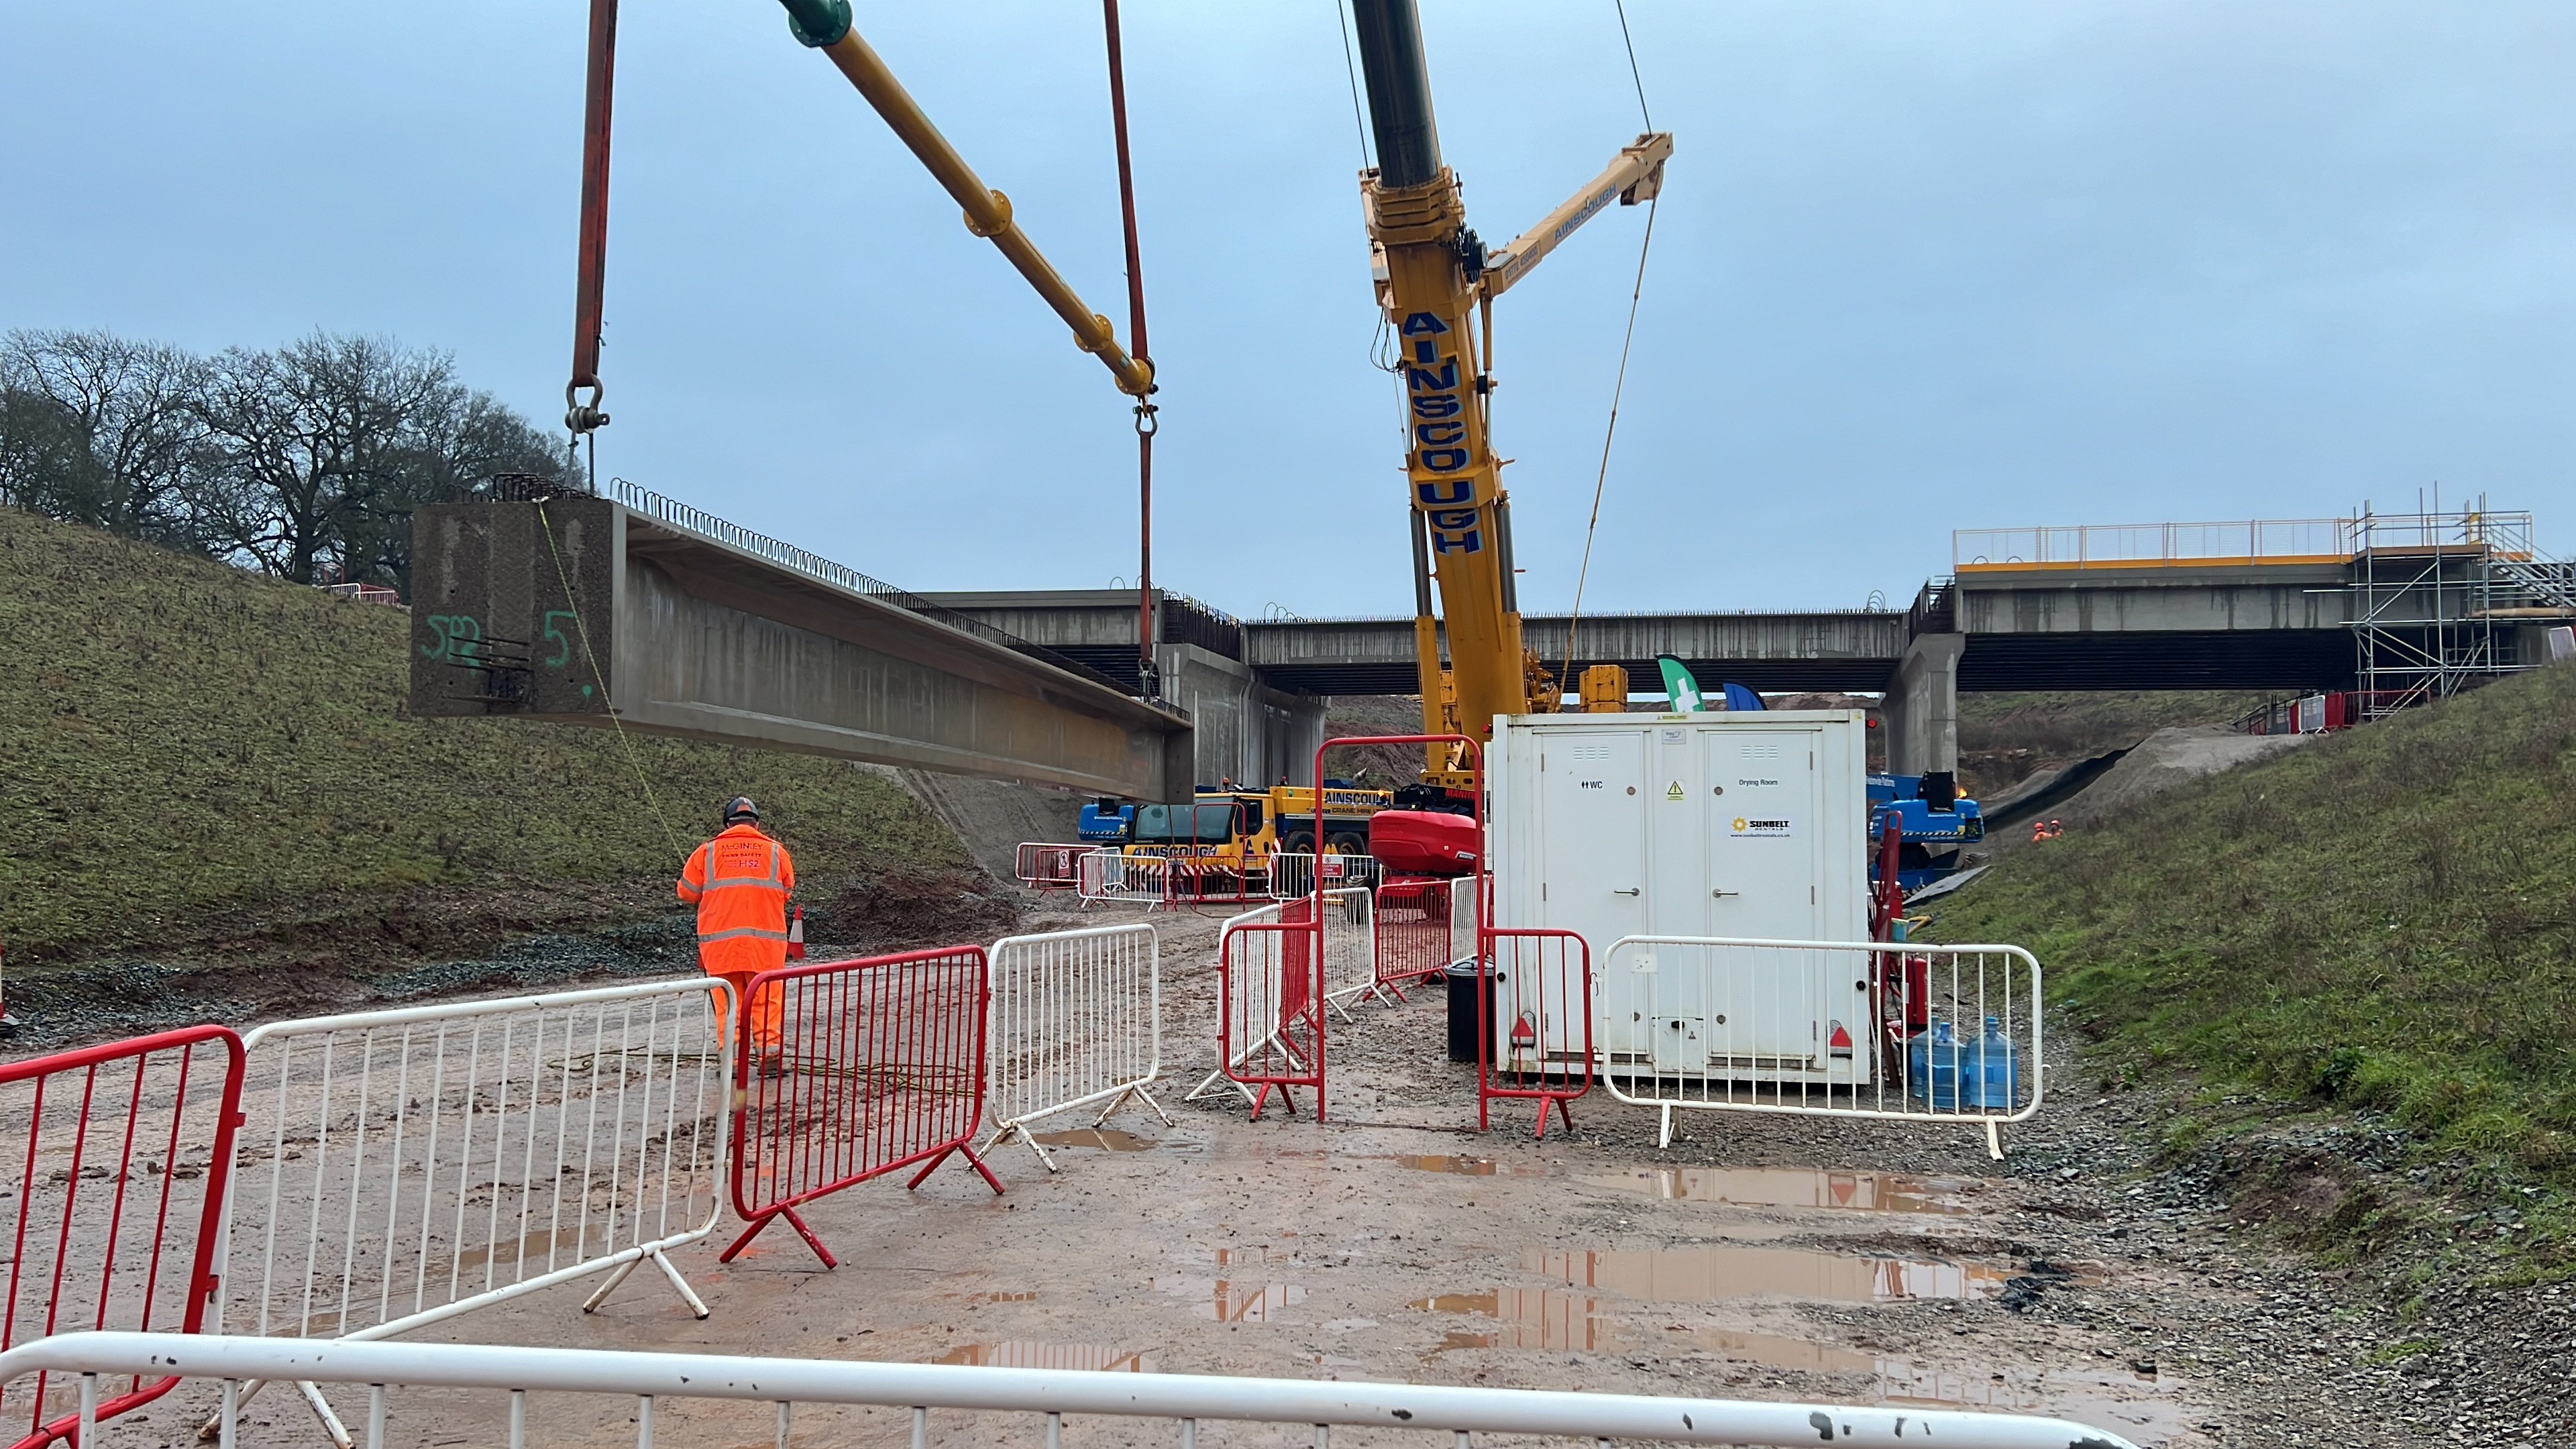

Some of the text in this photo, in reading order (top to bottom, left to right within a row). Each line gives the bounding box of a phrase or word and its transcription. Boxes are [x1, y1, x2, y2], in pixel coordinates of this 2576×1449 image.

[1554, 182, 1617, 242] AINSCOUGH
[1403, 311, 1483, 555] AINSCOUGH
[544, 610, 577, 668] 5
[1590, 781, 1603, 789] WC
[1325, 791, 1391, 805] AINSCOU
[1446, 788, 1476, 800] MANITO
[1133, 846, 1218, 858] AINSCOUGH
[739, 859, 759, 867] HS2
